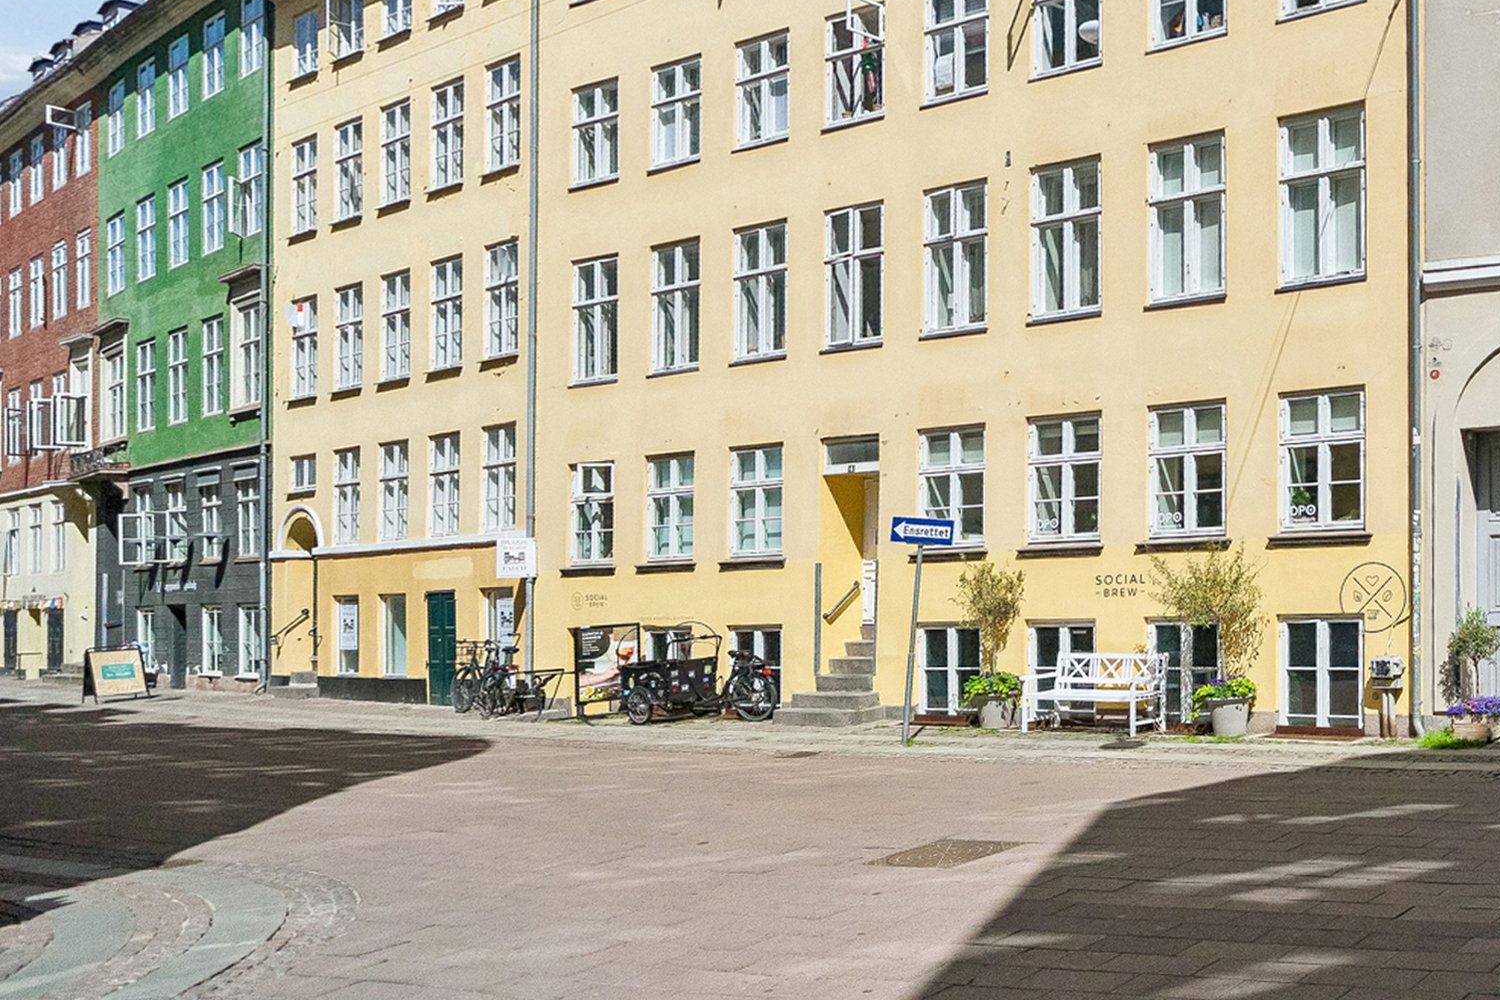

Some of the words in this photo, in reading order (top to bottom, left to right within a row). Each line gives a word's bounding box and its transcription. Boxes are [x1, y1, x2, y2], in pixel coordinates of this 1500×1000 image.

[903, 525, 949, 537] Ensrettet
[1095, 574, 1146, 586] SOCIAL
[584, 594, 608, 602] SOCIAL
